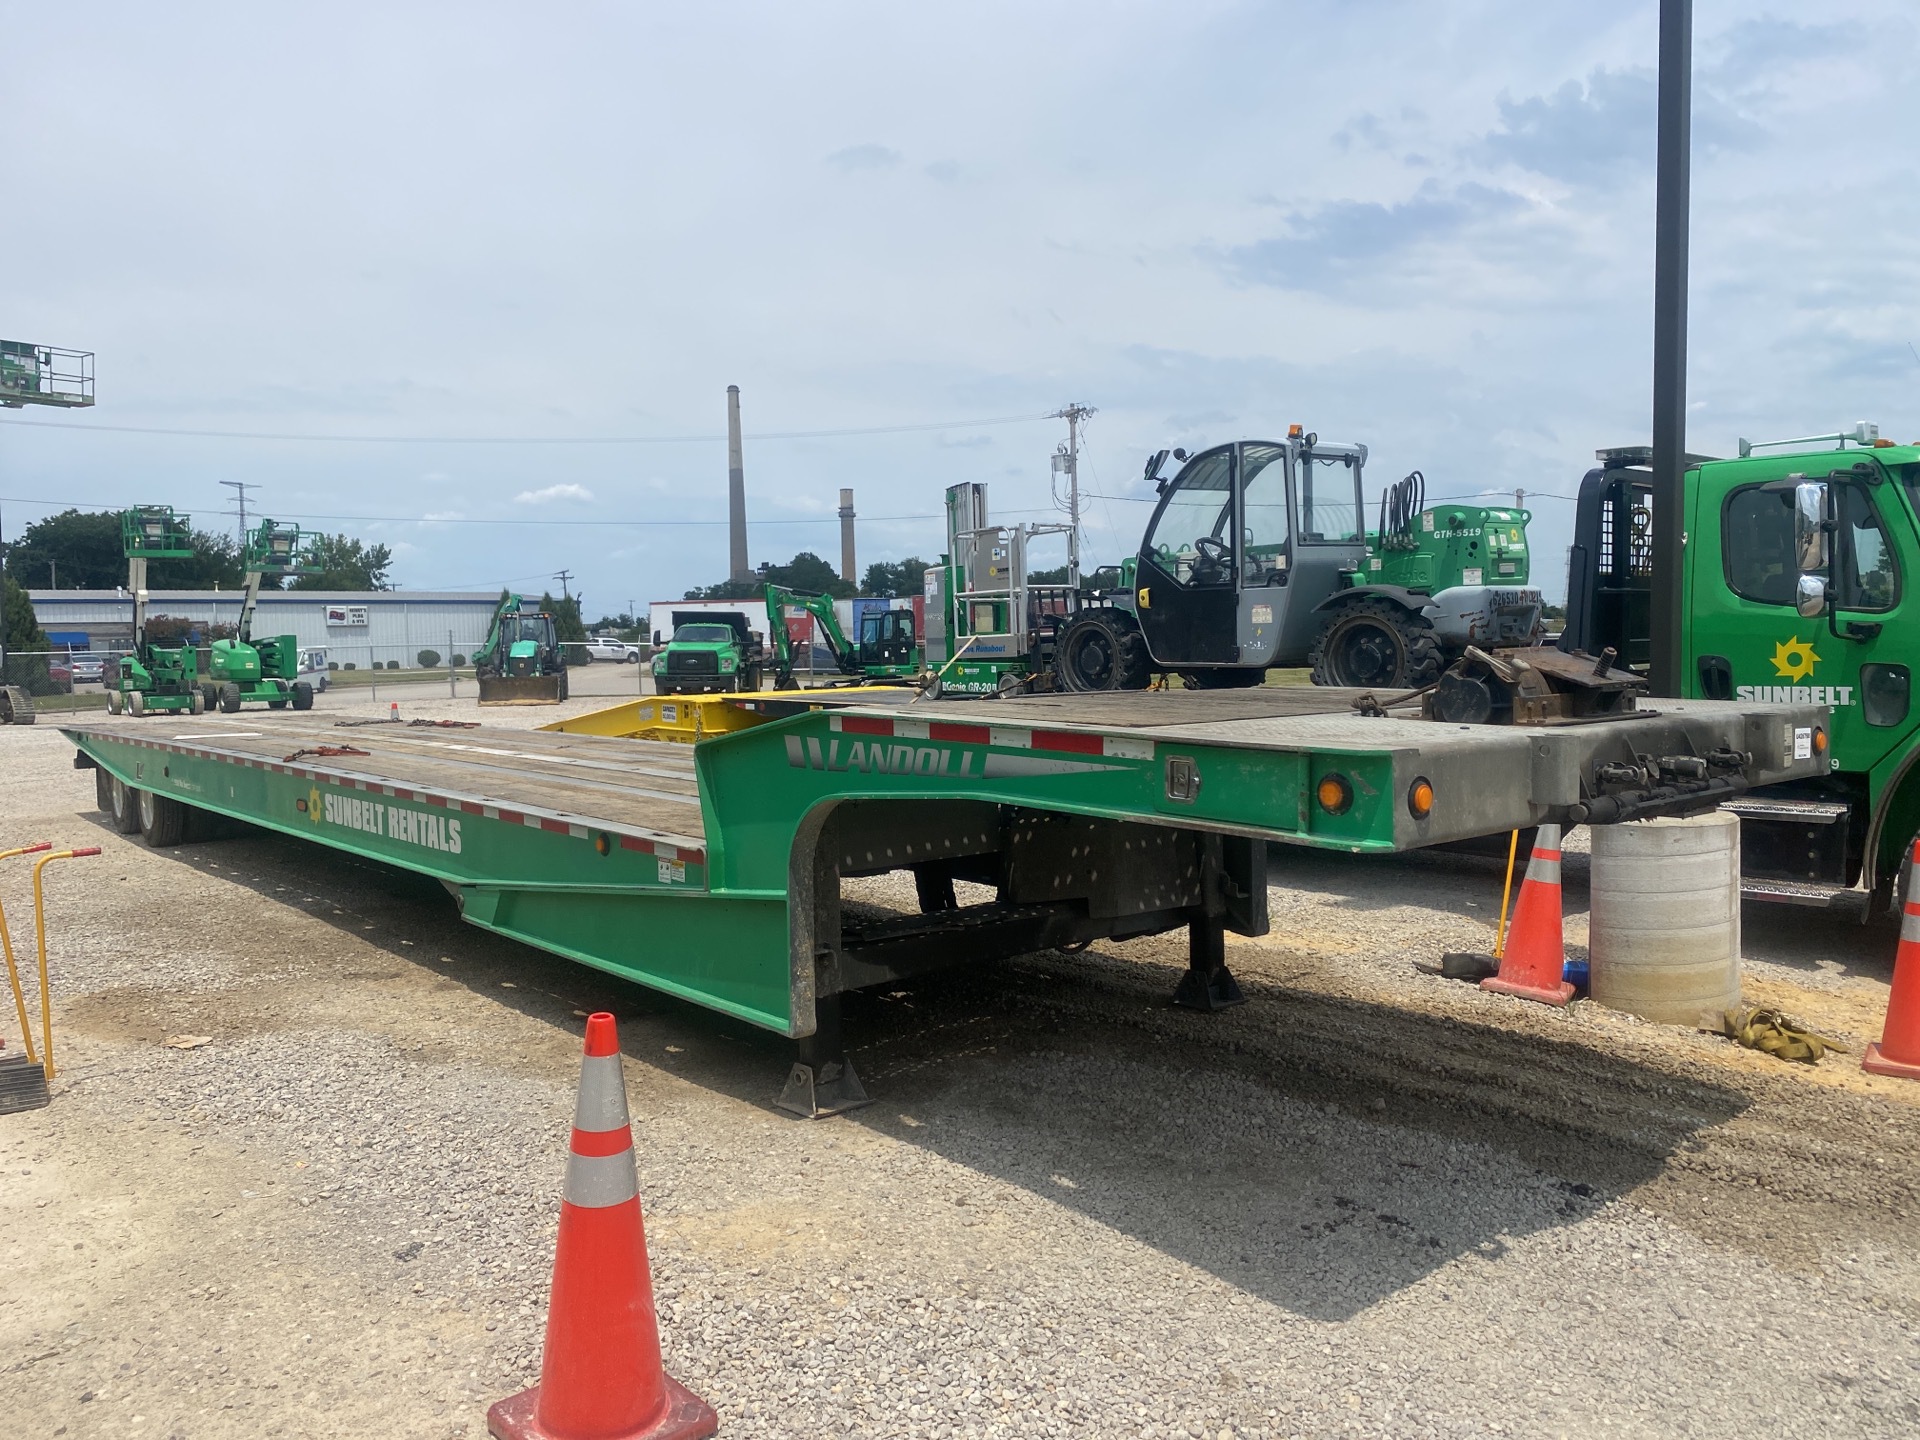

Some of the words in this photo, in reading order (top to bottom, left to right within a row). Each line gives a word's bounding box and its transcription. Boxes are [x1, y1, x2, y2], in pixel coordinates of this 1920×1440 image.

[1433, 527, 1481, 539] GTH-5519
[976, 644, 1006, 653] Runabout
[968, 681, 992, 693] GR-20
[1736, 685, 1853, 706] SUNBELT
[827, 739, 981, 779] LANDOLL
[324, 793, 384, 836] SUNBELT
[387, 806, 462, 855] RENTALS
